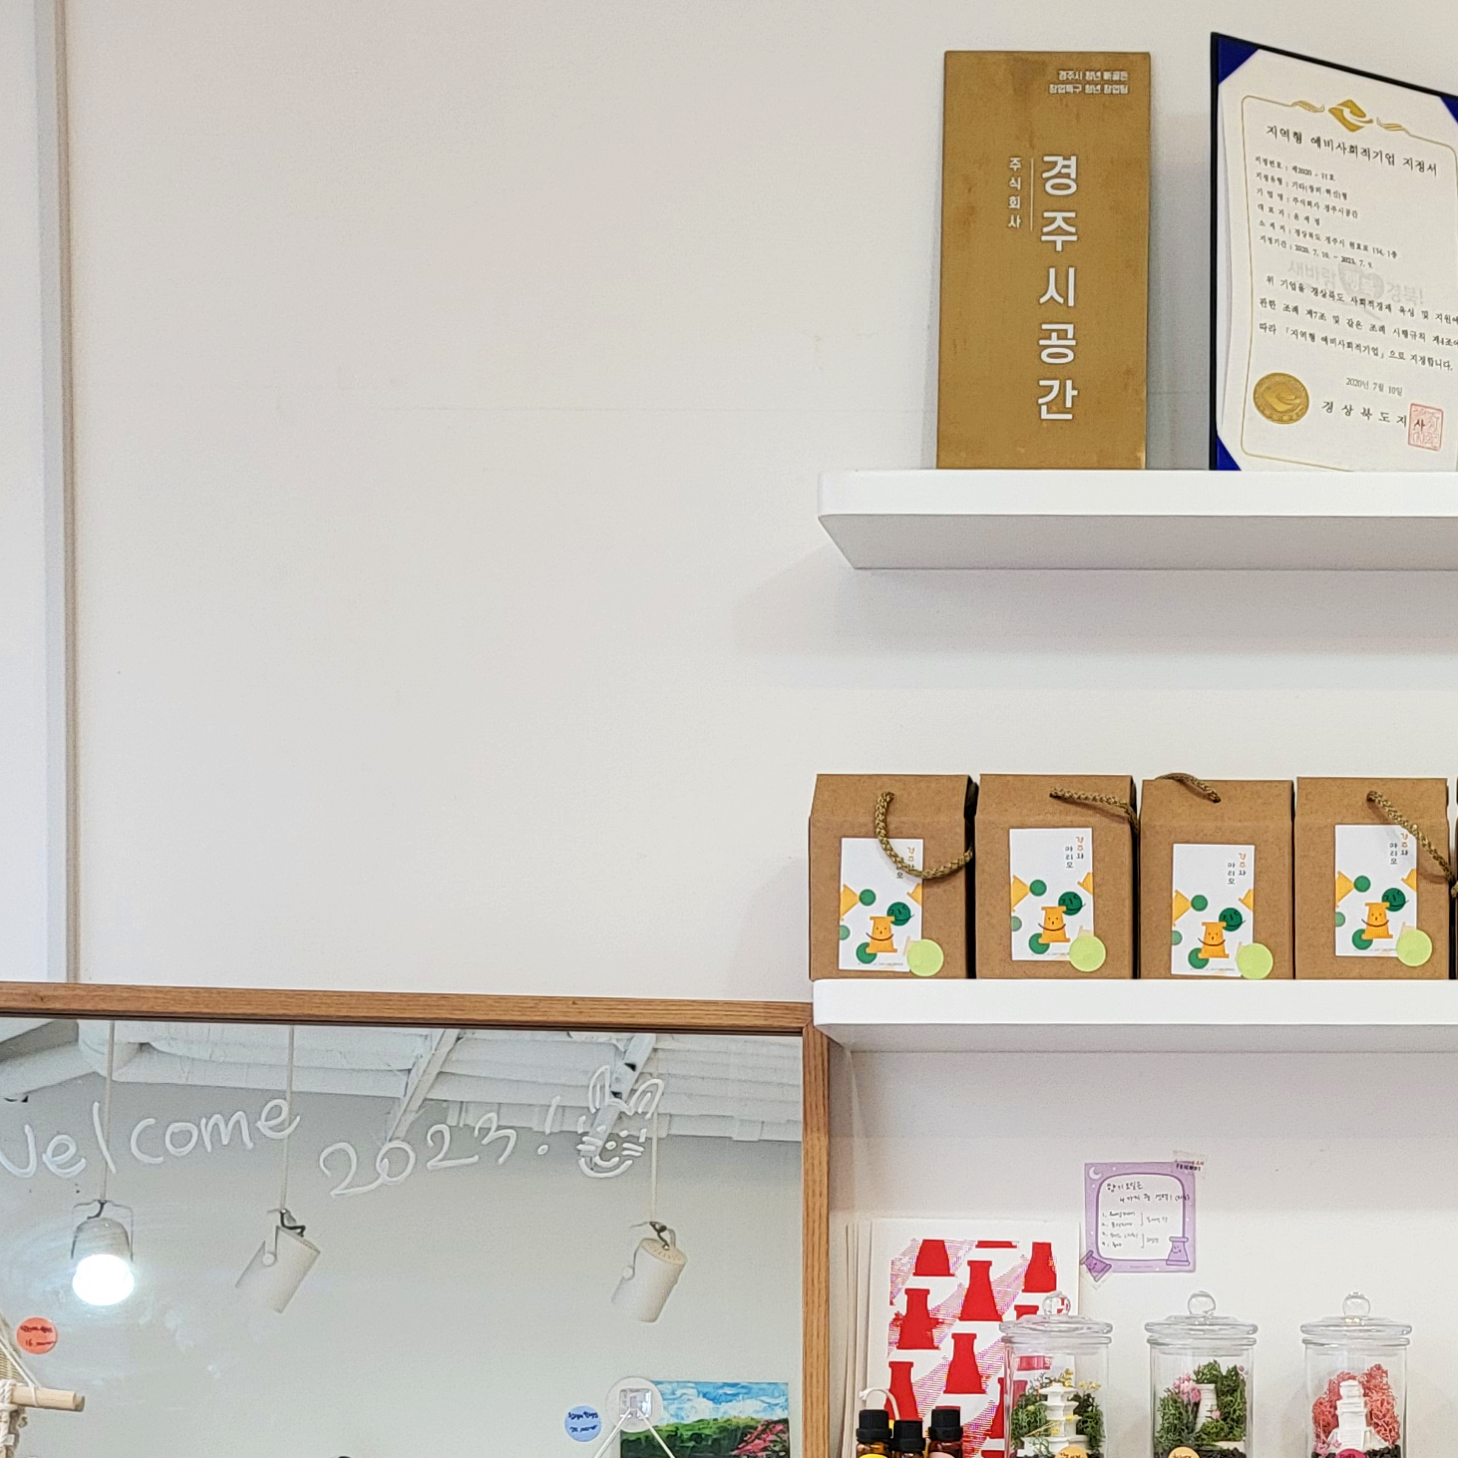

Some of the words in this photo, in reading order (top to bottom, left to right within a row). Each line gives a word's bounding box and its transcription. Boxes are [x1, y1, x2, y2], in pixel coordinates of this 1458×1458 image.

[1266, 126, 1302, 145] 지역형
[1311, 136, 1395, 166] 예비사회적기업
[1403, 157, 1437, 177] 지정서
[1007, 156, 1022, 230] 주식회사
[1037, 154, 1079, 421] 경주시공간
[1311, 286, 1345, 303] 경상북도
[1065, 845, 1074, 869] 마리모
[1075, 836, 1085, 860] 경주와
[1389, 841, 1399, 866] 마리모
[1400, 832, 1410, 857] 경주와
[1226, 861, 1236, 886] 마리모
[1237, 852, 1247, 877] 경주와
